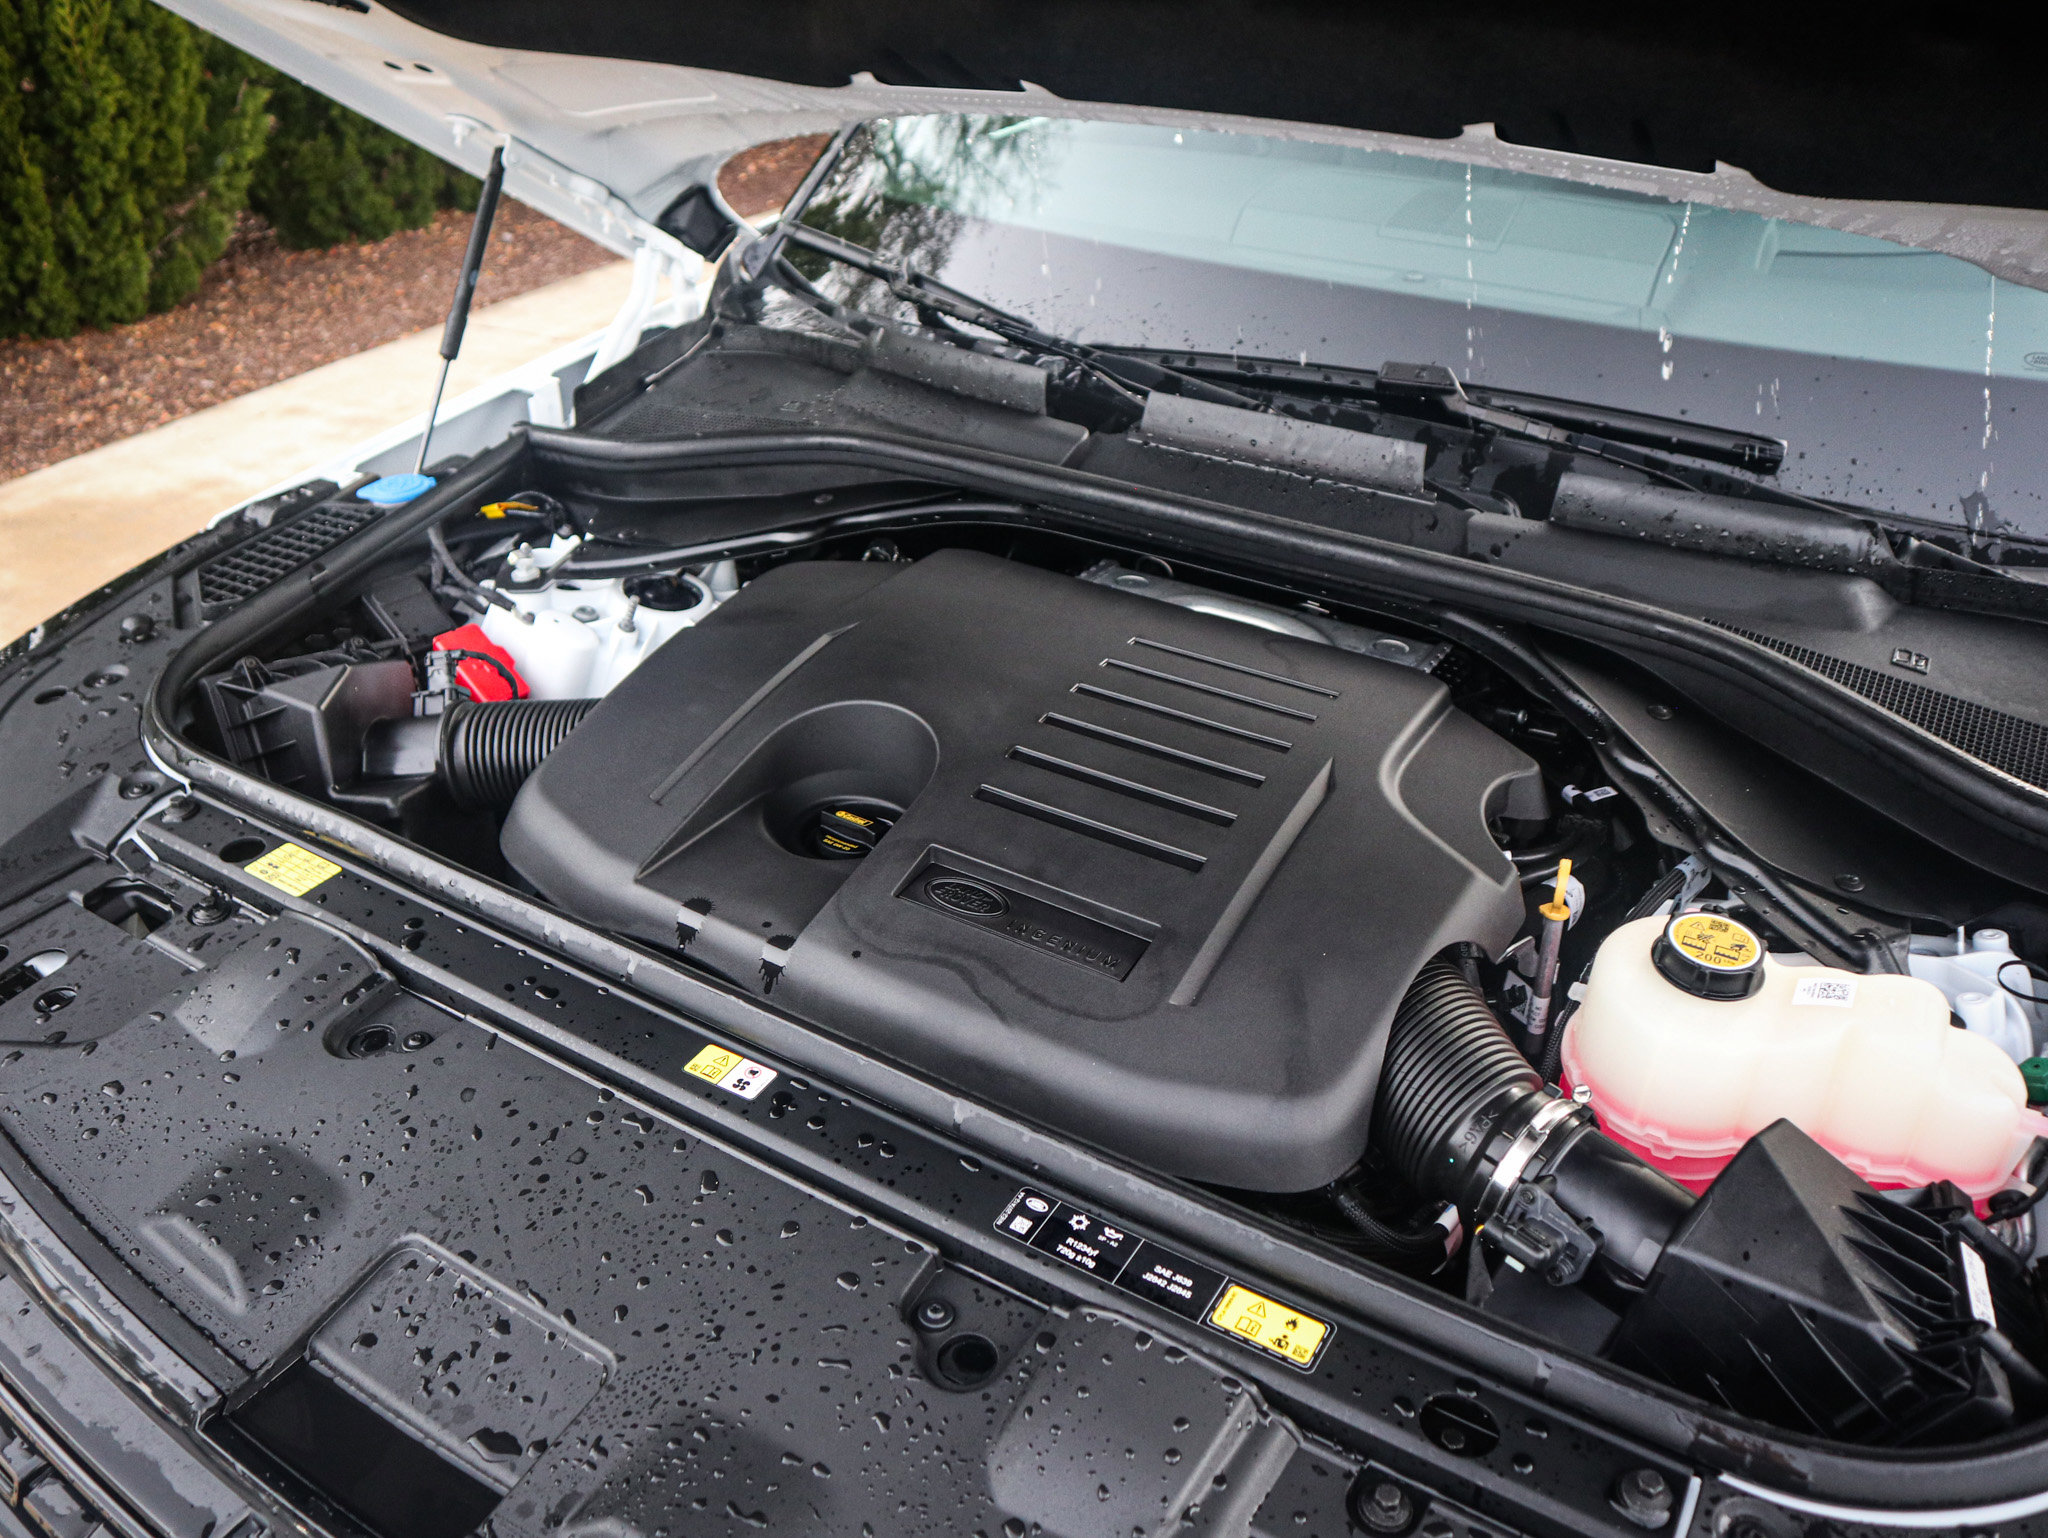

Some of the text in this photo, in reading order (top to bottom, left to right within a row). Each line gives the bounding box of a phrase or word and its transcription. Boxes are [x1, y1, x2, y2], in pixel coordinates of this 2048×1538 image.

[1006, 919, 1121, 970] INGENIUM
[1695, 950, 1722, 964] 200
[1056, 1243, 1076, 1260] 720g
[1065, 1236, 1100, 1257] R1234yf
[1153, 1264, 1174, 1279] SAE
